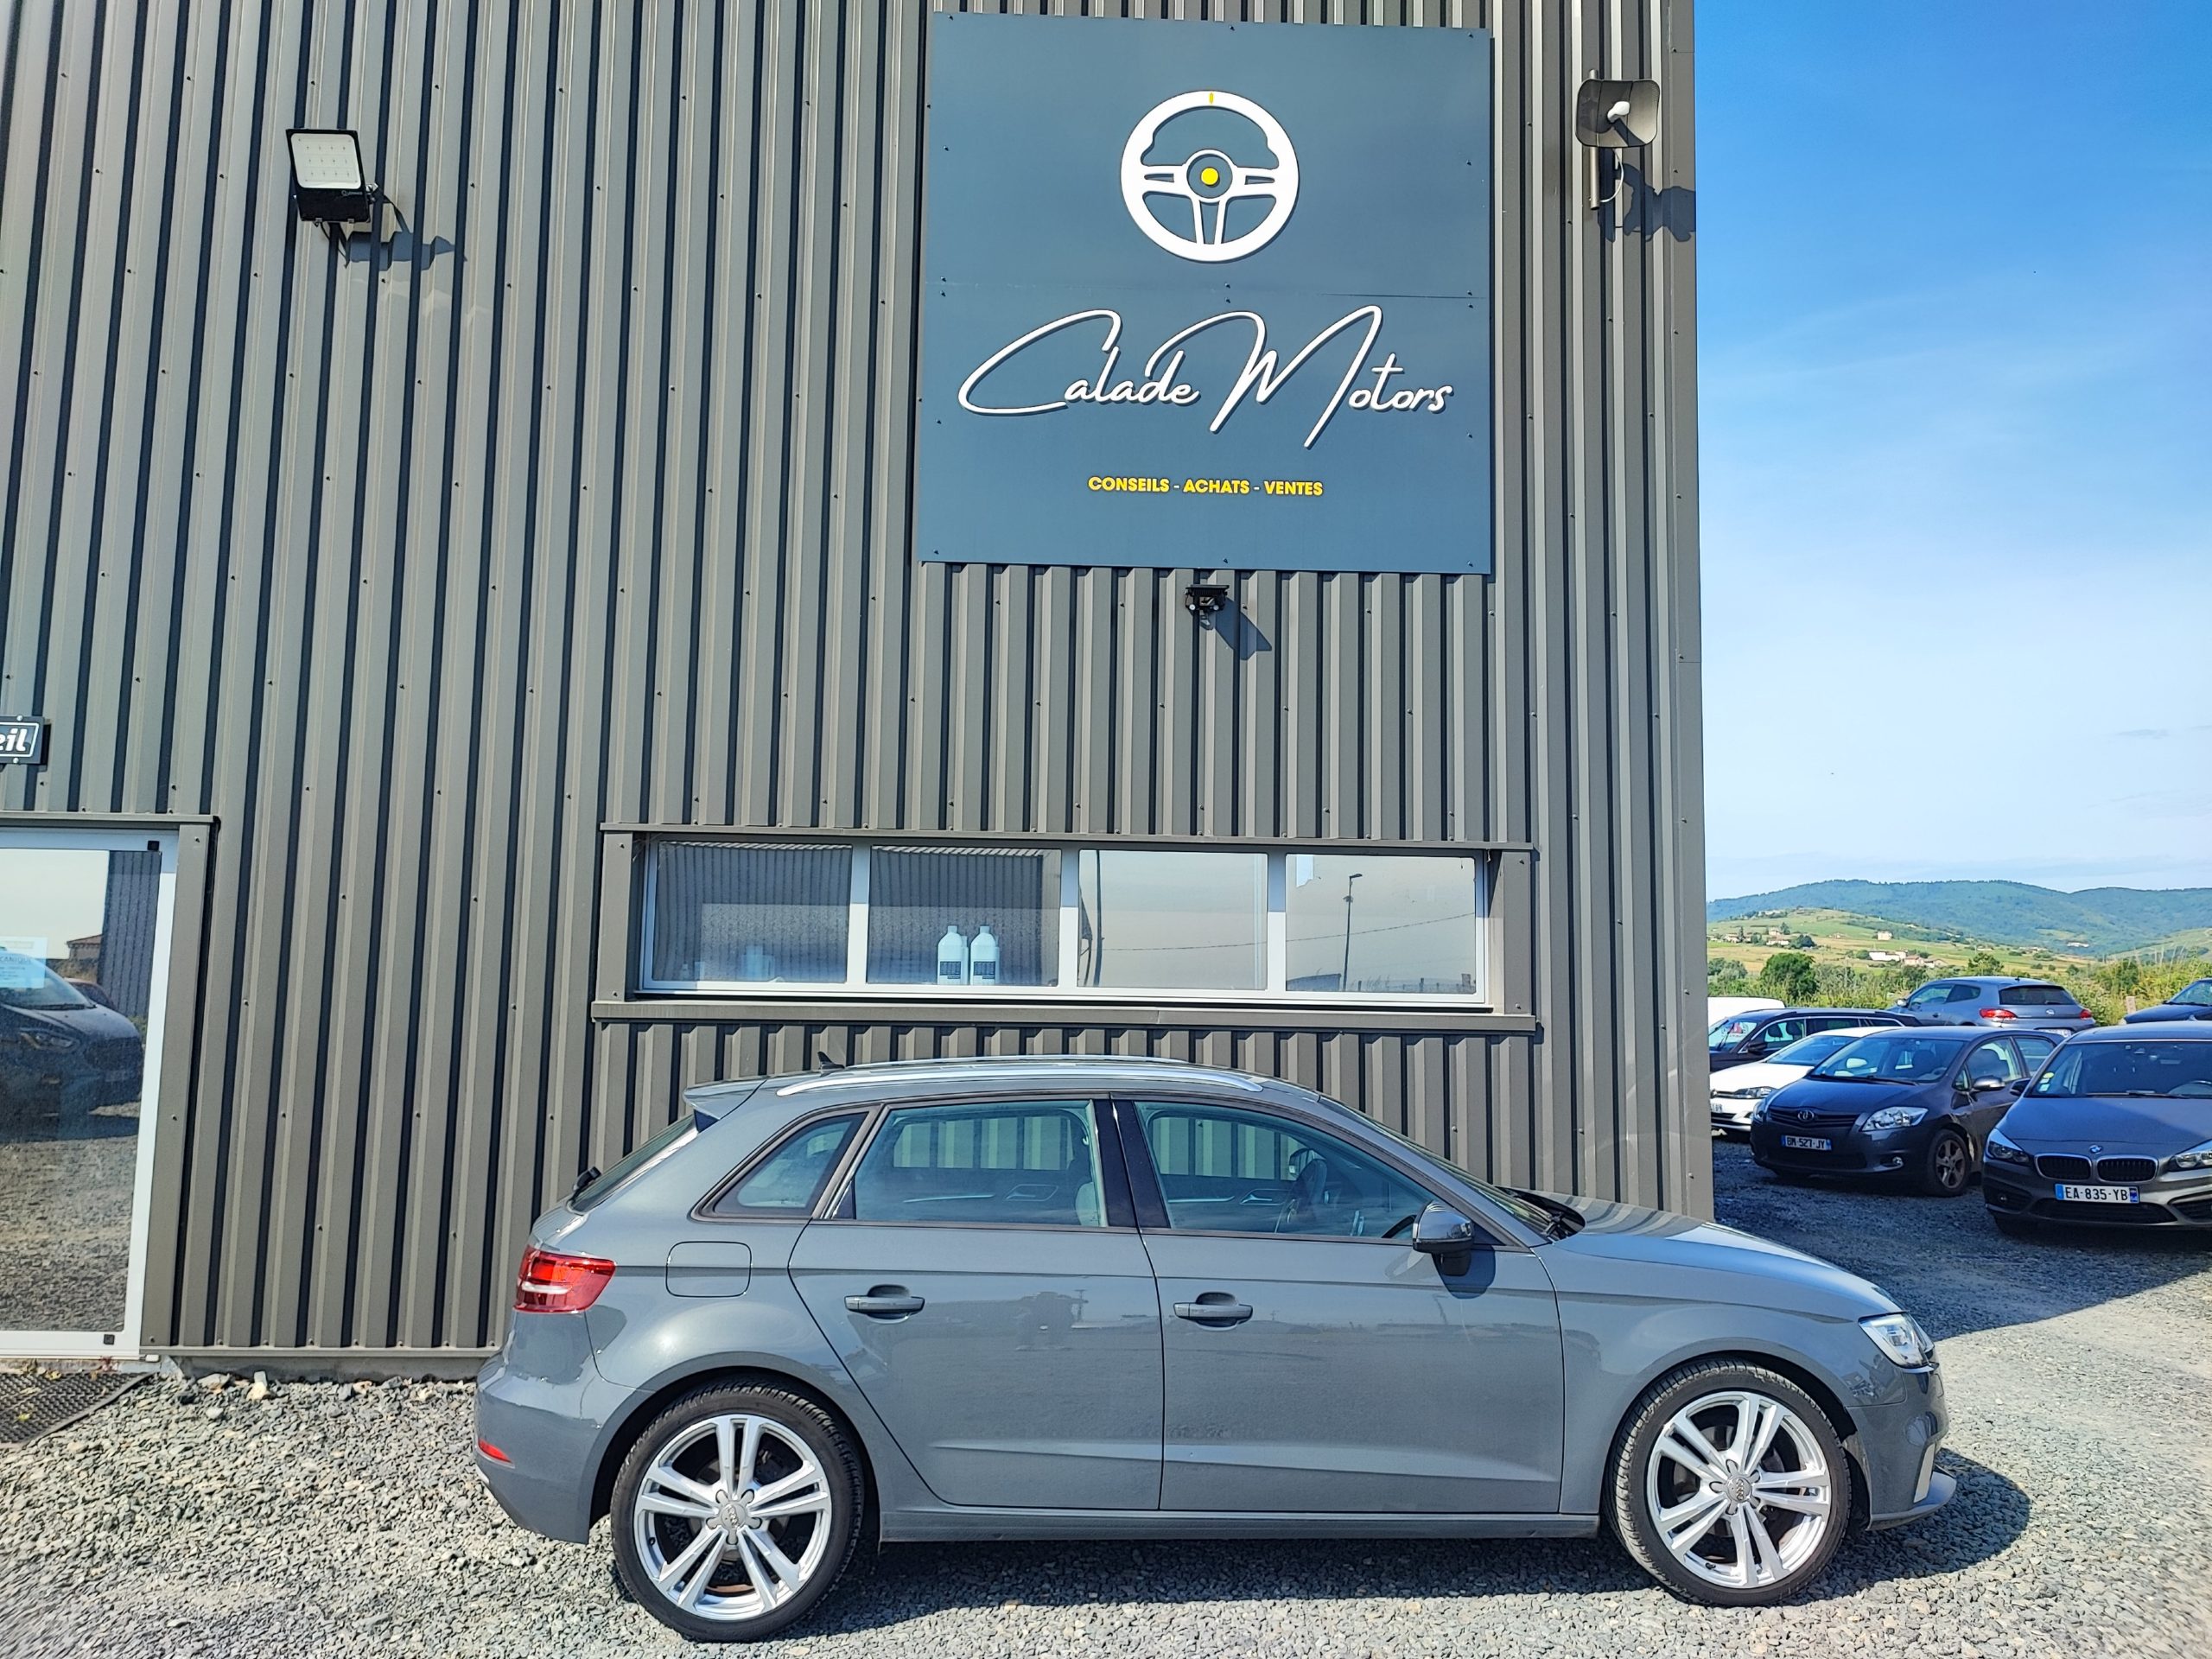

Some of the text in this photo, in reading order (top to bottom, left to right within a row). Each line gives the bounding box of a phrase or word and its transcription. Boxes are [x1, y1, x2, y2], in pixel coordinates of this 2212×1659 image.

[957, 304, 1454, 448] Calade Motors
[1088, 476, 1170, 493] CONSEILS
[1183, 479, 1250, 494] ACHATS
[1263, 480, 1324, 496] VENTES
[2064, 1186, 2128, 1201] EA-835-YB
